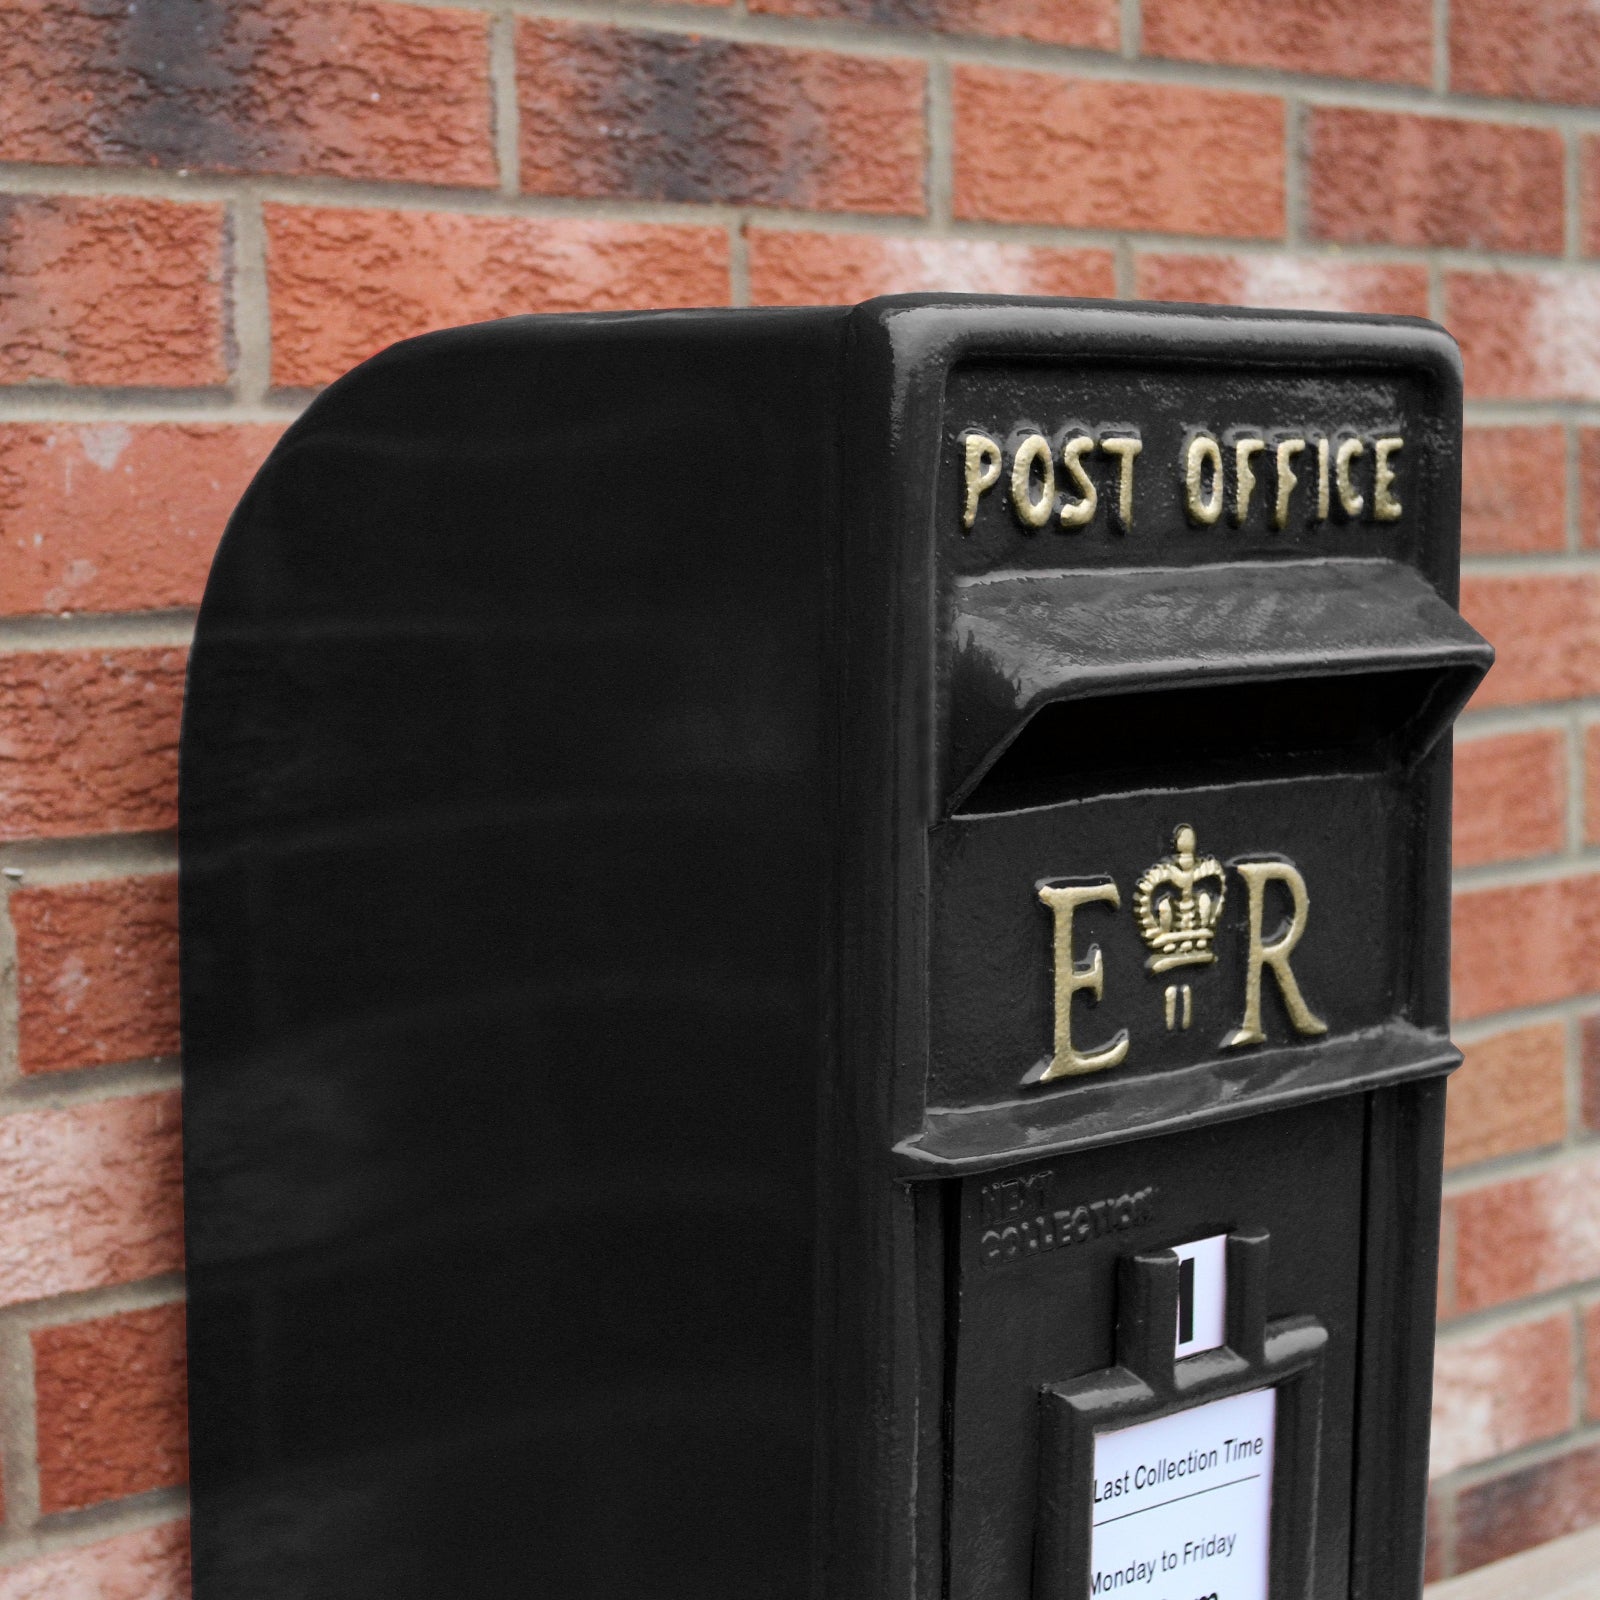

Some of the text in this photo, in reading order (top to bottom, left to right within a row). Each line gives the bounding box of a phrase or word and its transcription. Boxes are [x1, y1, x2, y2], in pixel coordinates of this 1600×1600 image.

[964, 433, 1404, 533] POST OFFICE
[1036, 861, 1329, 1082] E R
[980, 1186, 1157, 1267] COLLECTION
[981, 1170, 1054, 1226] NEXT
[1093, 1436, 1264, 1503] Last Collection Time
[1091, 1532, 1237, 1596] Monday to Friday
